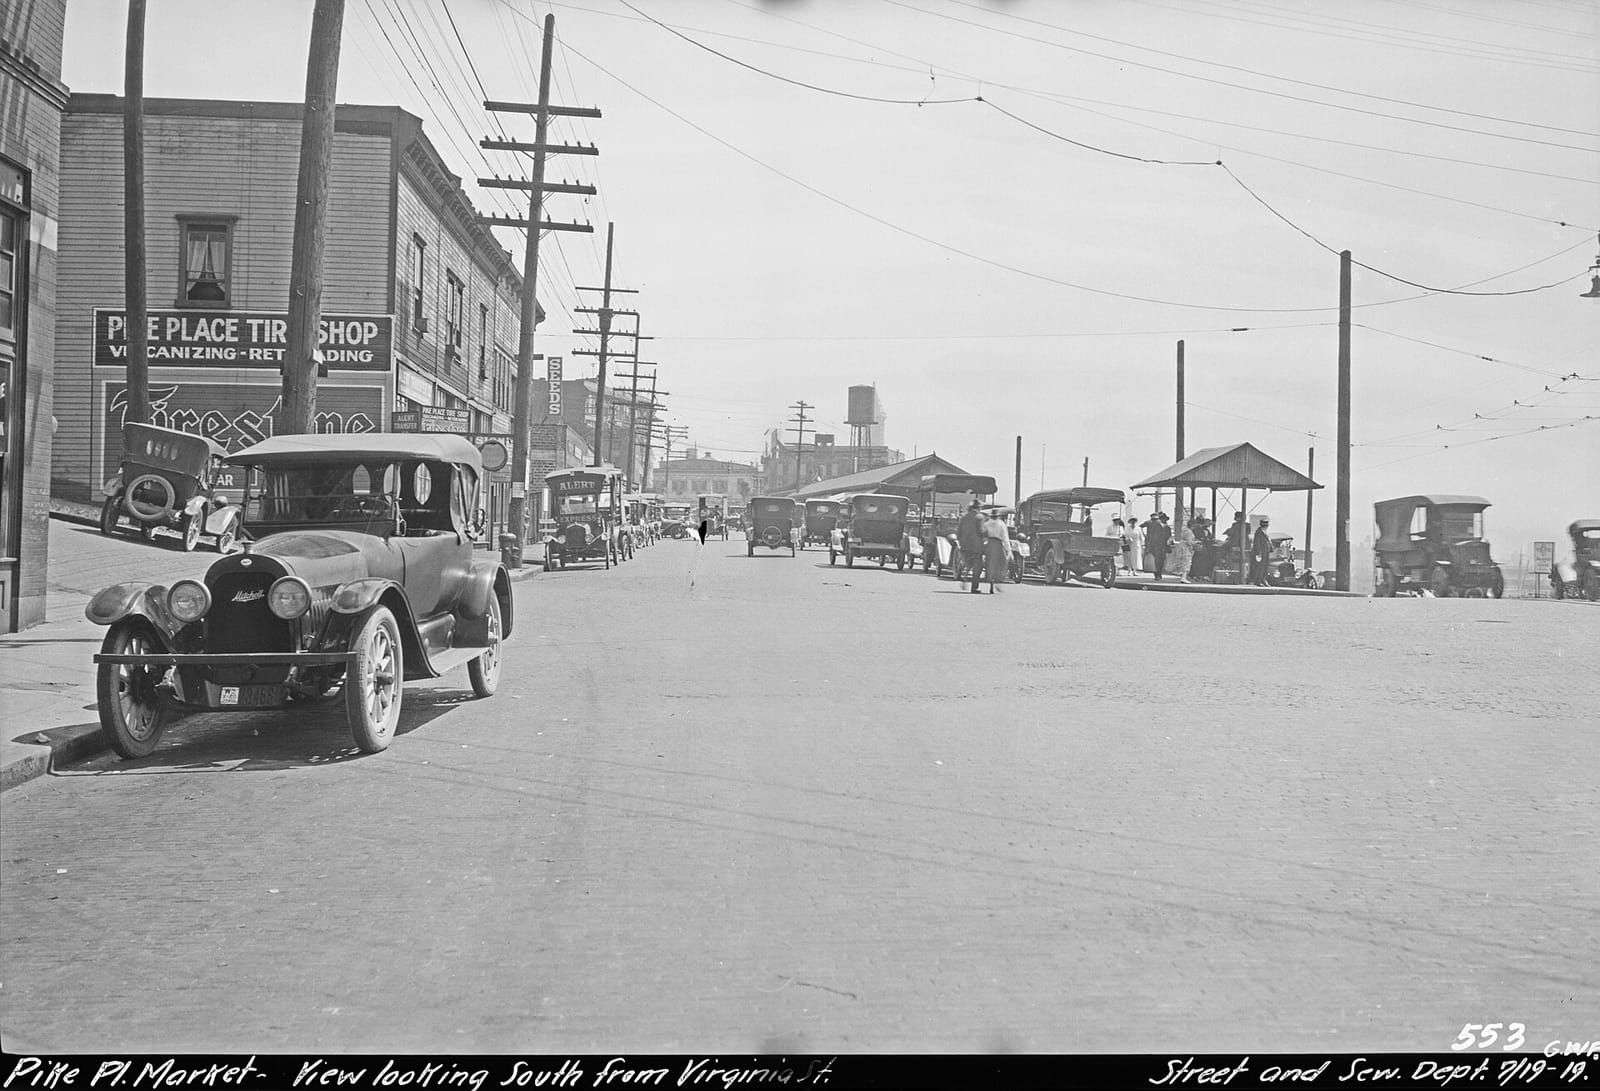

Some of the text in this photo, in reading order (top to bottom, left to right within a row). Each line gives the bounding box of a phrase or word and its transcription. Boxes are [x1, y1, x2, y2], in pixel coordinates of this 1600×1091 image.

[108, 315, 378, 345] PIE PLACE TIR SHOP
[109, 345, 237, 360] VCANIZING
[249, 347, 374, 363] RETDING
[549, 358, 561, 415] SEEDS
[110, 385, 376, 451] Firestne
[560, 480, 596, 491] ALERT
